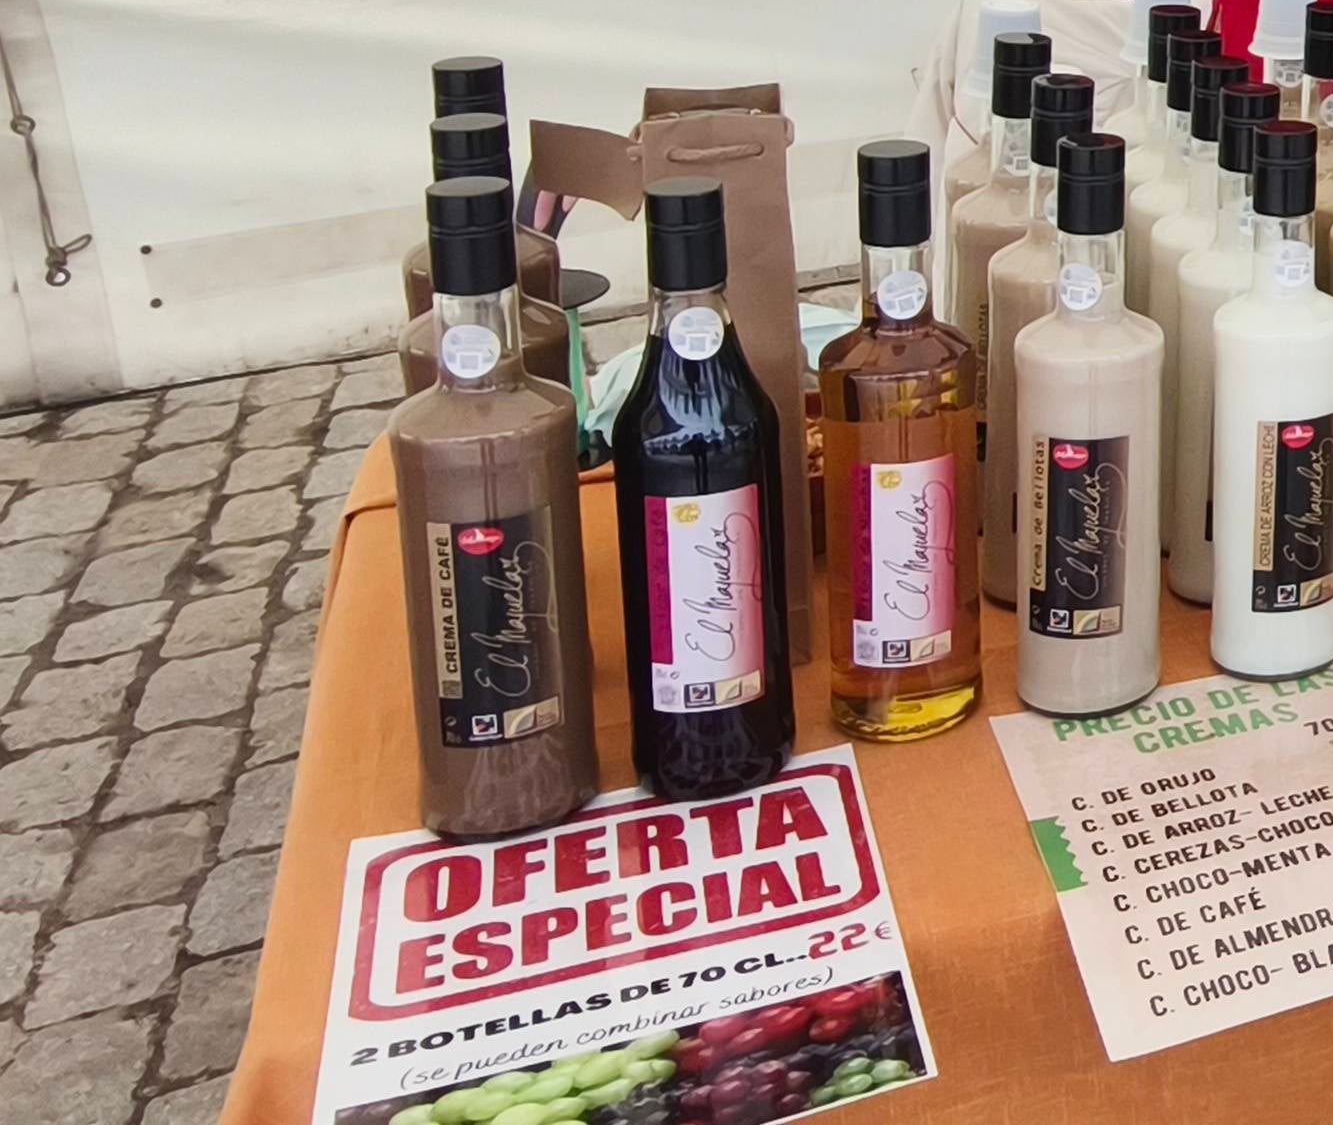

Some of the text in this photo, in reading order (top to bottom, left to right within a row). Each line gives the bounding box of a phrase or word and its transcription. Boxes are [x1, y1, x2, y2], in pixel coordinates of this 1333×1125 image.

[1262, 461, 1273, 481] CON
[1032, 441, 1045, 586] Crema de Bellotas
[1260, 482, 1273, 514] ARROZ
[1260, 515, 1273, 530] DE
[1259, 531, 1273, 566] CREMA
[1283, 532, 1322, 570] El
[884, 580, 930, 621] El
[1055, 556, 1099, 600] El
[437, 536, 458, 674] CREMA DE CAFÉ
[685, 619, 736, 661] El
[474, 653, 531, 697] El
[1053, 697, 1196, 741] PRECIO
[1208, 684, 1259, 710] DE
[1133, 703, 1299, 754] CREMAS
[1072, 768, 1216, 811] C. DE ORUJO
[1081, 782, 1259, 833] C. DE BELLOTA
[404, 786, 828, 922] OFERTA
[1091, 841, 1115, 856] C.
[1122, 830, 1156, 850] DE
[1164, 808, 1253, 840] ARROZ-
[1102, 865, 1126, 883] C.
[1113, 842, 1332, 912] C. CHOCO-MENTA
[396, 852, 840, 994] ESPECIAL
[1124, 886, 1267, 944] C. DE CAFÉ
[1137, 959, 1162, 980] C.
[1170, 945, 1205, 971] DE
[351, 1046, 379, 1066] 2
[387, 991, 611, 1057] BOTELLAS
[620, 978, 671, 1002] DE
[679, 966, 726, 987] 70
[875, 920, 893, 942] €
[1150, 995, 1175, 1017] C.
[1183, 964, 1284, 1007] CHOCO-
[453, 1037, 567, 1082] pueden
[576, 999, 709, 1047] combinar
[719, 966, 835, 1012] sabores)
